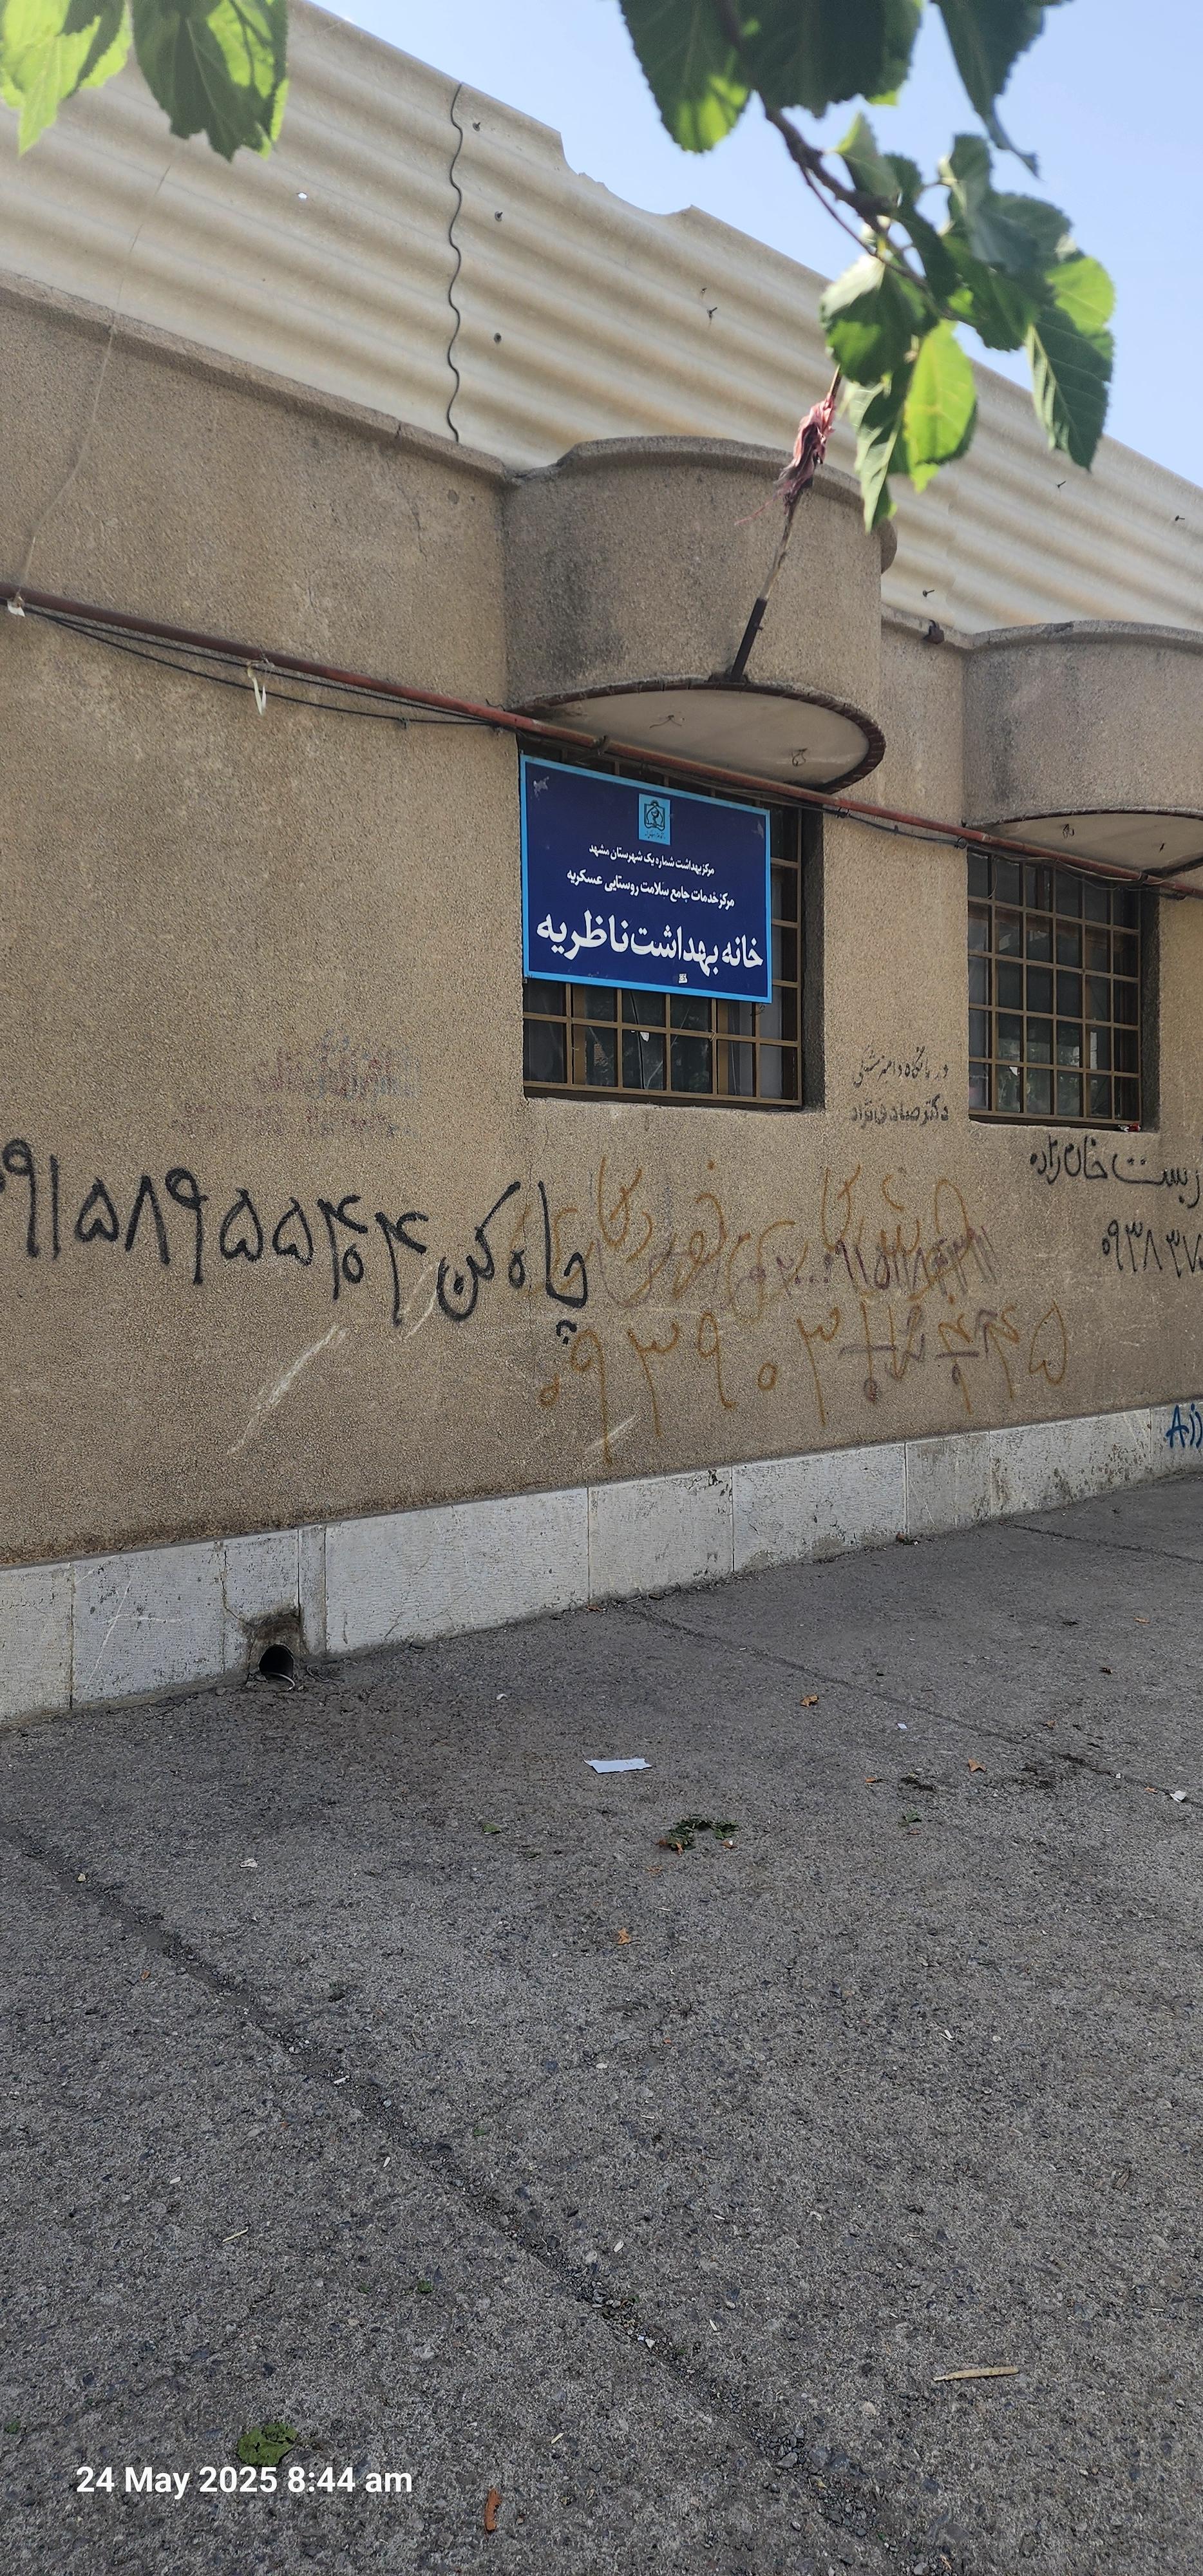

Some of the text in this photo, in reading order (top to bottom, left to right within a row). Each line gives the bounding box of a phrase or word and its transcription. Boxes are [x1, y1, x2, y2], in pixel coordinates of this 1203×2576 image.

[567, 869, 735, 910] مرکز خدمات جامع سلامت روستایی عسکریه
[589, 844, 715, 877] مرکز بهداشت شماره یک شهرستان مشهد
[536, 909, 763, 977] خانه بهداشت ناظریه
[920, 1093, 949, 1126] دکتر
[0, 1138, 430, 1327] ۹۱۵۸۹۵۵۴۰۴
[435, 1181, 522, 1321] کن
[1101, 1219, 1203, 1278] ۰۹۳۸۳۷
